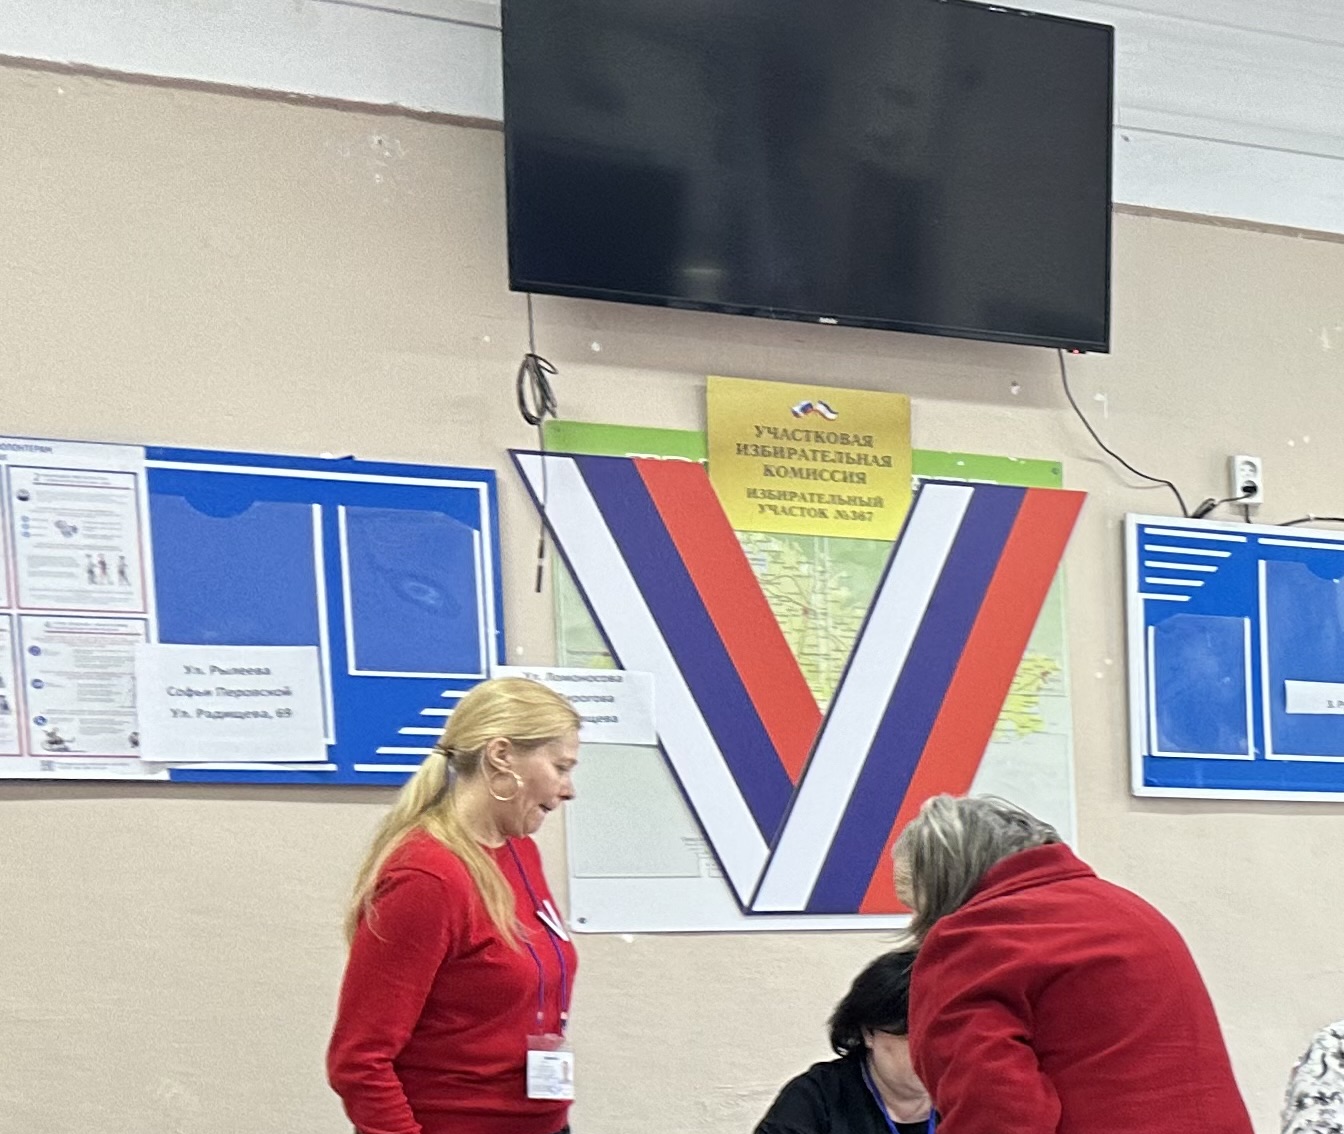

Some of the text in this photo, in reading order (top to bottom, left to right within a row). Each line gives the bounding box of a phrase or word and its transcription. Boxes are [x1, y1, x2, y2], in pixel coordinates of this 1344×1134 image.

[753, 424, 874, 448] УЧАСТКОВАЯ
[735, 442, 893, 468] ИЗБИРАТЕЛЬНАЯ
[763, 463, 867, 485] КОМИССИЯ
[746, 487, 885, 509] ИЗБИРАТЕЛЬНЫЙ
[758, 503, 829, 520] УЧАСТОК
[545, 671, 623, 683] Ломоносова
[166, 686, 293, 698] Софьи Перовской
